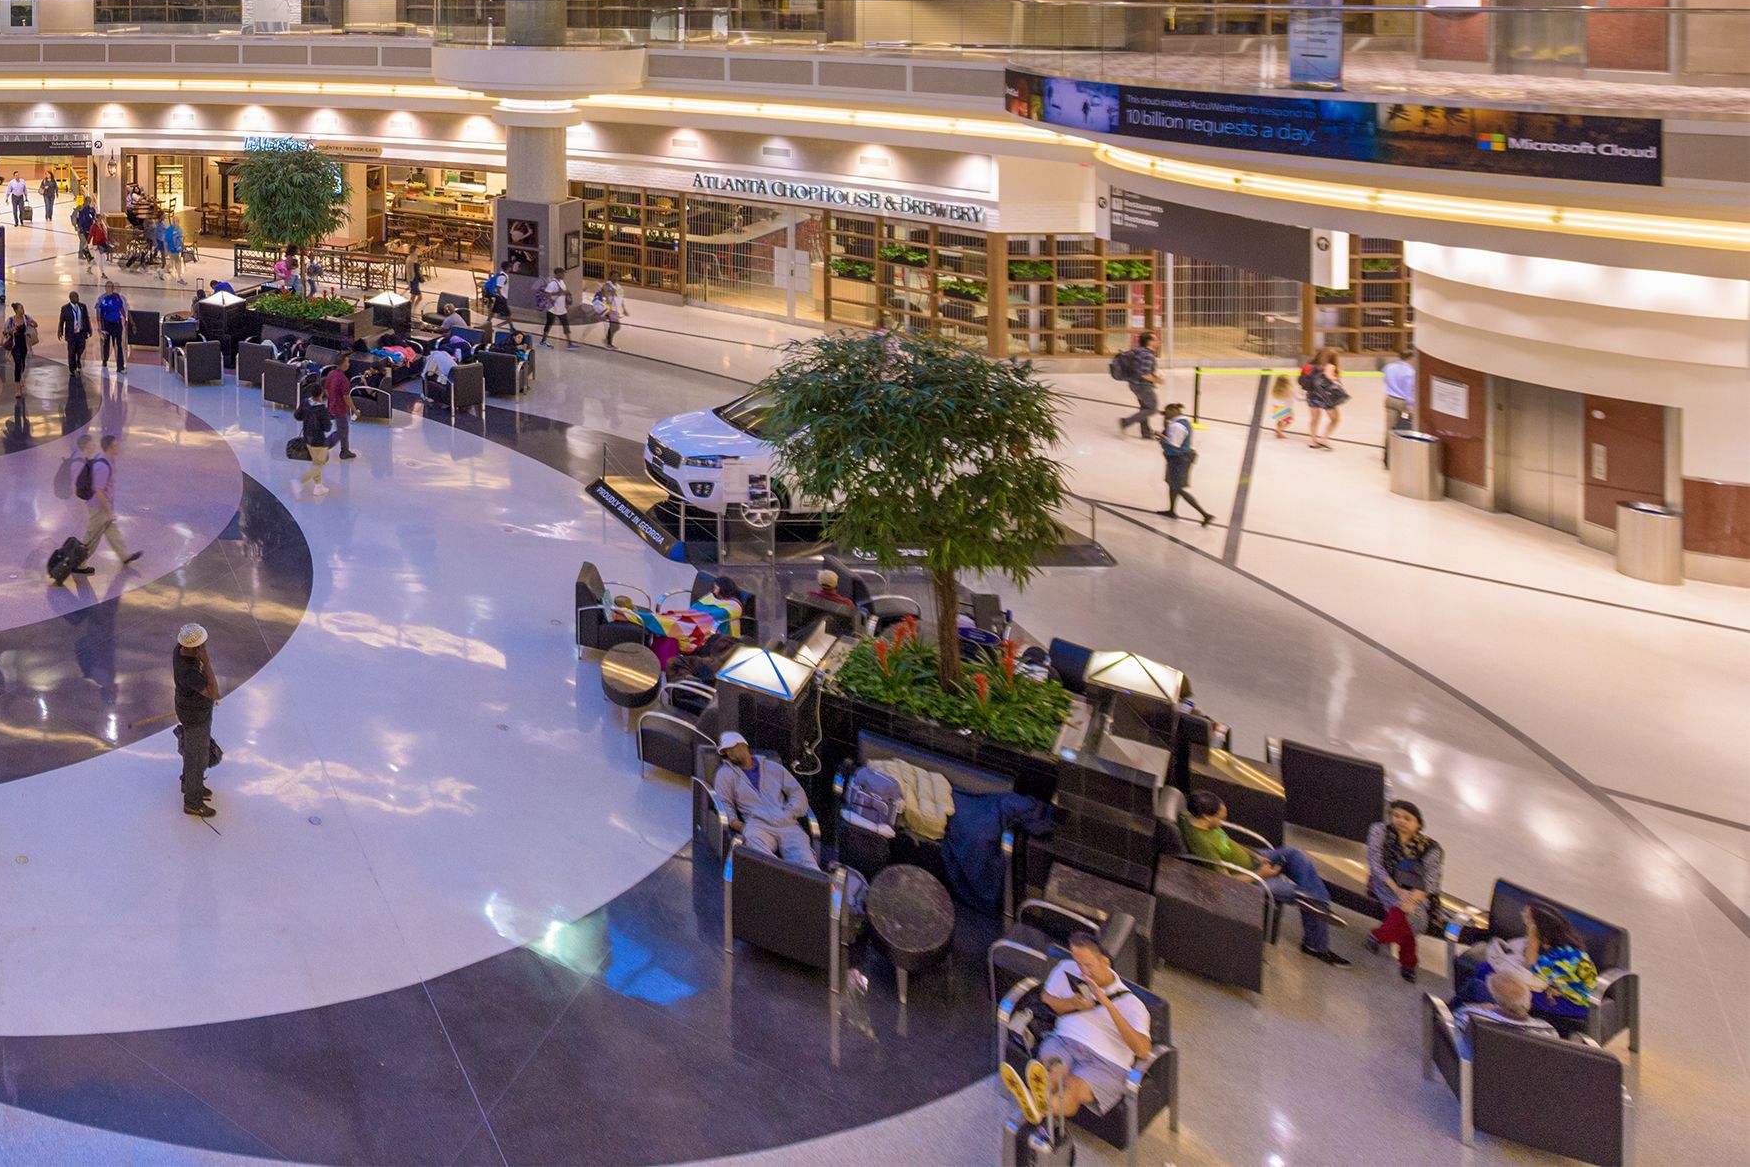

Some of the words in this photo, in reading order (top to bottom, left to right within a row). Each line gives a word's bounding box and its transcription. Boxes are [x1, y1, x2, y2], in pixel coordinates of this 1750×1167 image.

[1190, 101, 1246, 114] AccuWeather
[41, 134, 89, 142] NORTH
[1126, 109, 1141, 125] 10
[1142, 110, 1184, 130] billion
[1185, 117, 1258, 137] requests
[1260, 125, 1274, 139] a
[1276, 123, 1317, 146] day.
[1508, 137, 1597, 155] Microsoft
[1597, 143, 1657, 159] Cloud
[692, 173, 768, 195] ATLANTA
[771, 181, 881, 210] CHOPHOUSE
[883, 195, 899, 211] &
[900, 196, 986, 223] BREWERY
[596, 486, 620, 507] PROUDLY
[617, 503, 634, 519] BUILT
[631, 515, 641, 525] IN
[638, 521, 665, 545] GEORGIA
